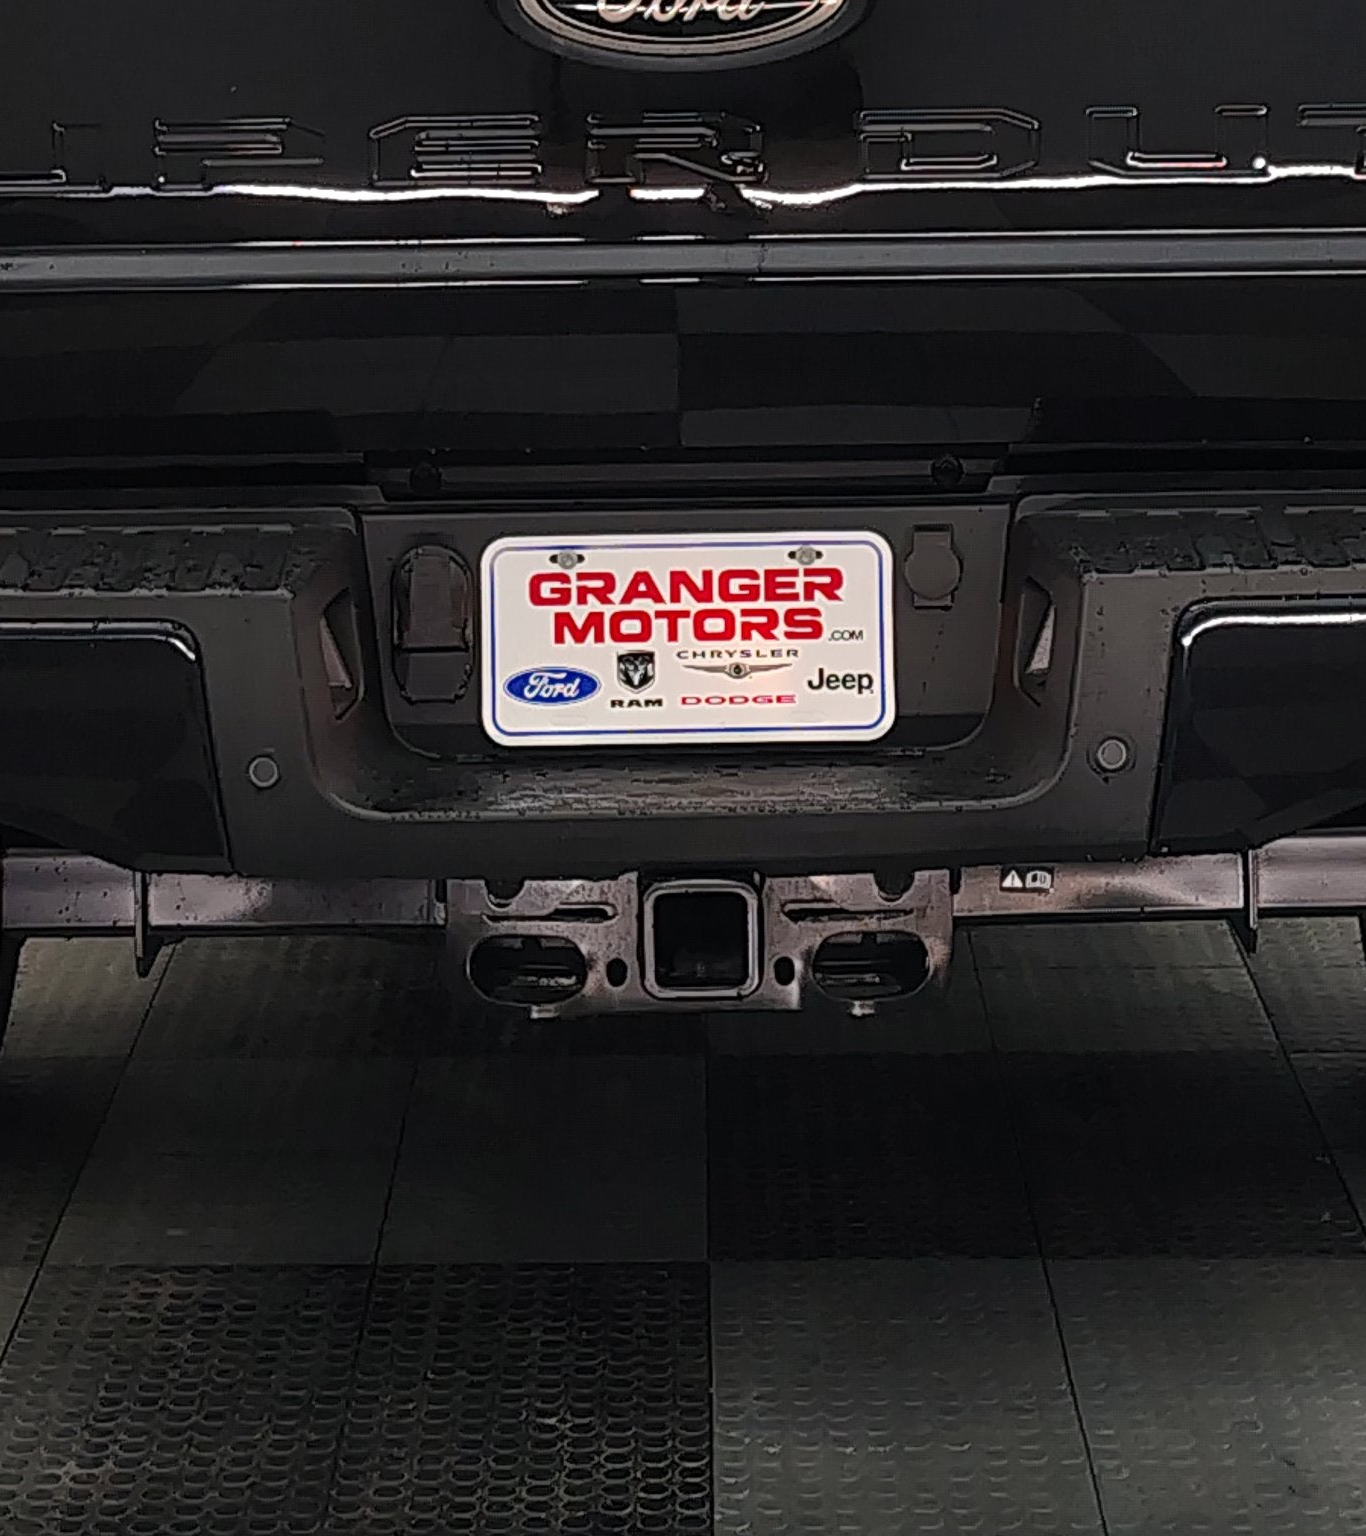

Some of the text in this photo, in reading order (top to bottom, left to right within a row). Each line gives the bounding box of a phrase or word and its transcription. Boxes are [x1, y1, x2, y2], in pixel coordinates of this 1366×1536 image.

[528, 568, 844, 606] GRANGER
[554, 608, 823, 644] MOTORS
[676, 648, 799, 659] CHRYSLER
[523, 672, 581, 699] Ford
[807, 668, 874, 694] Jeep
[610, 698, 663, 708] RAM
[681, 695, 797, 705] DODGE
